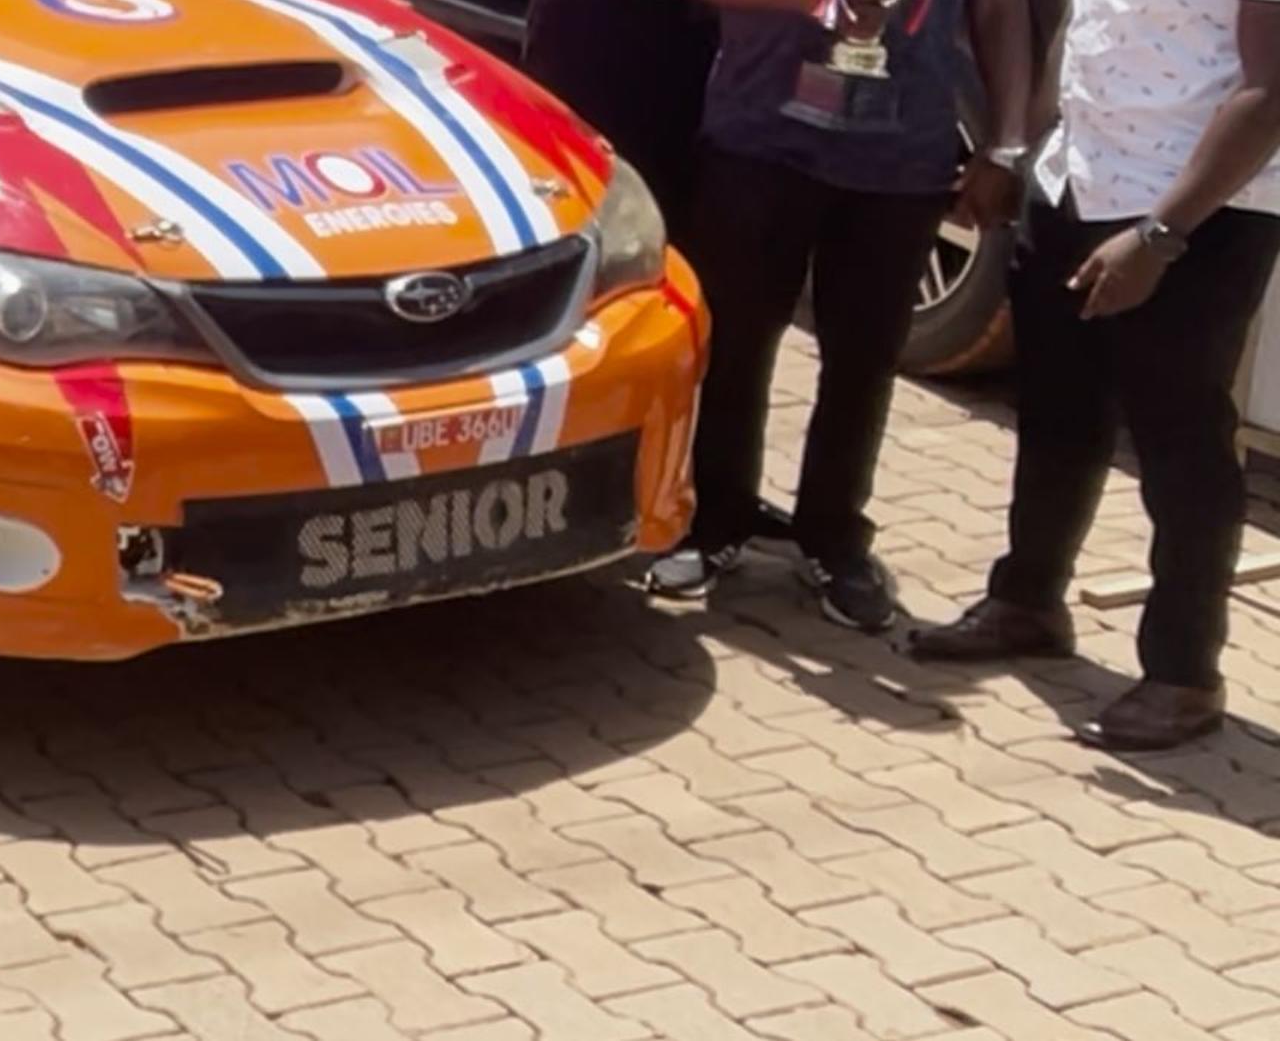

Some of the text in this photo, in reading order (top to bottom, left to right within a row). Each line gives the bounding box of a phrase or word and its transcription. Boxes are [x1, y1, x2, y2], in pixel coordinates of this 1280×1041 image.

[227, 148, 461, 211] MOIL
[303, 200, 458, 239] ENERGIES
[401, 420, 451, 451] UBE
[296, 468, 570, 589] SENIOR
